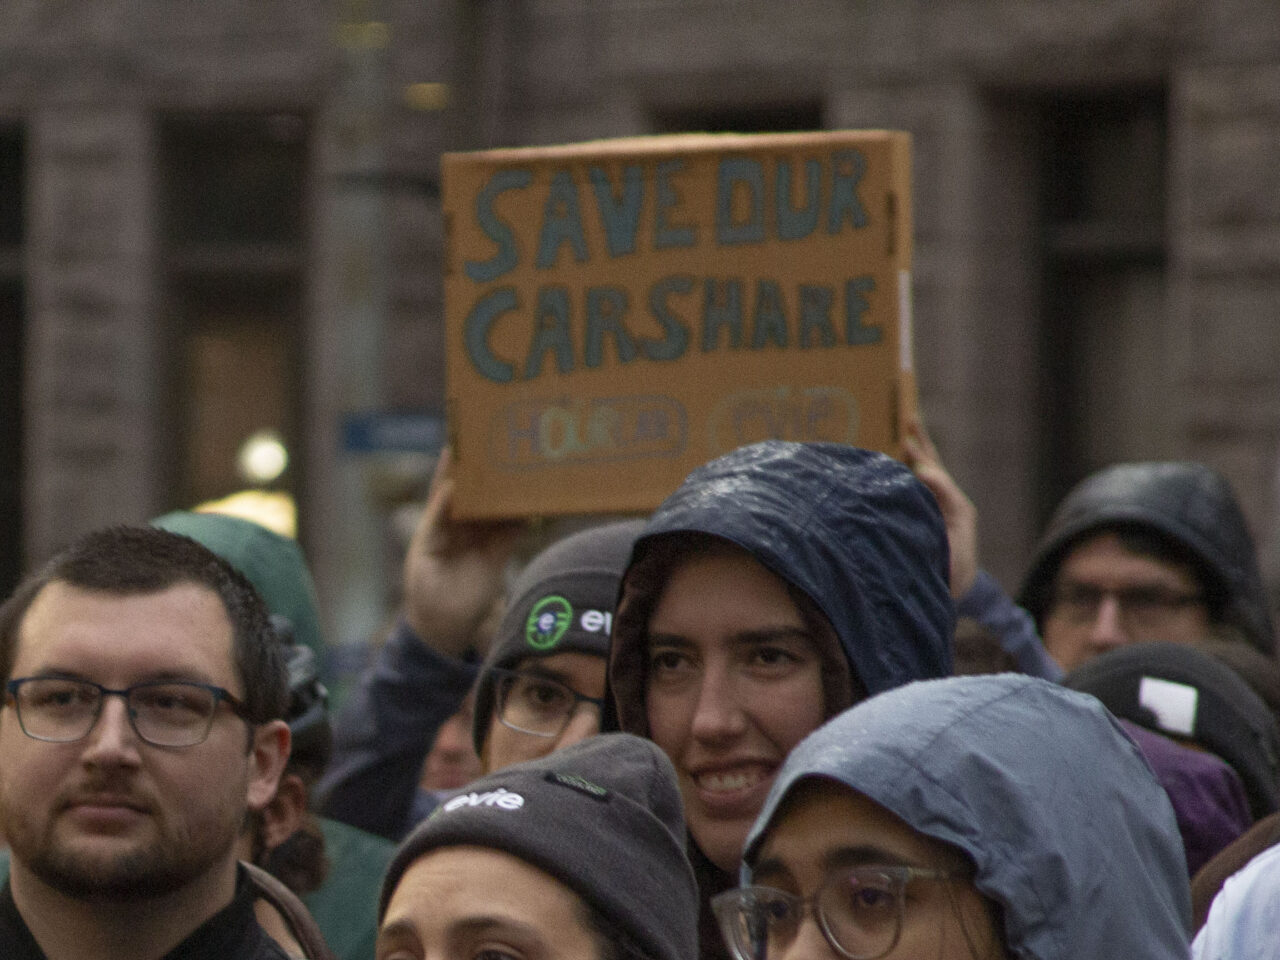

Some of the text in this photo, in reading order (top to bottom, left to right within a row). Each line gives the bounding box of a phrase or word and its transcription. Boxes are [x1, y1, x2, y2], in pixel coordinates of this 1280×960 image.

[463, 148, 870, 284] SAVE OUR
[463, 276, 884, 384] CARSHARE
